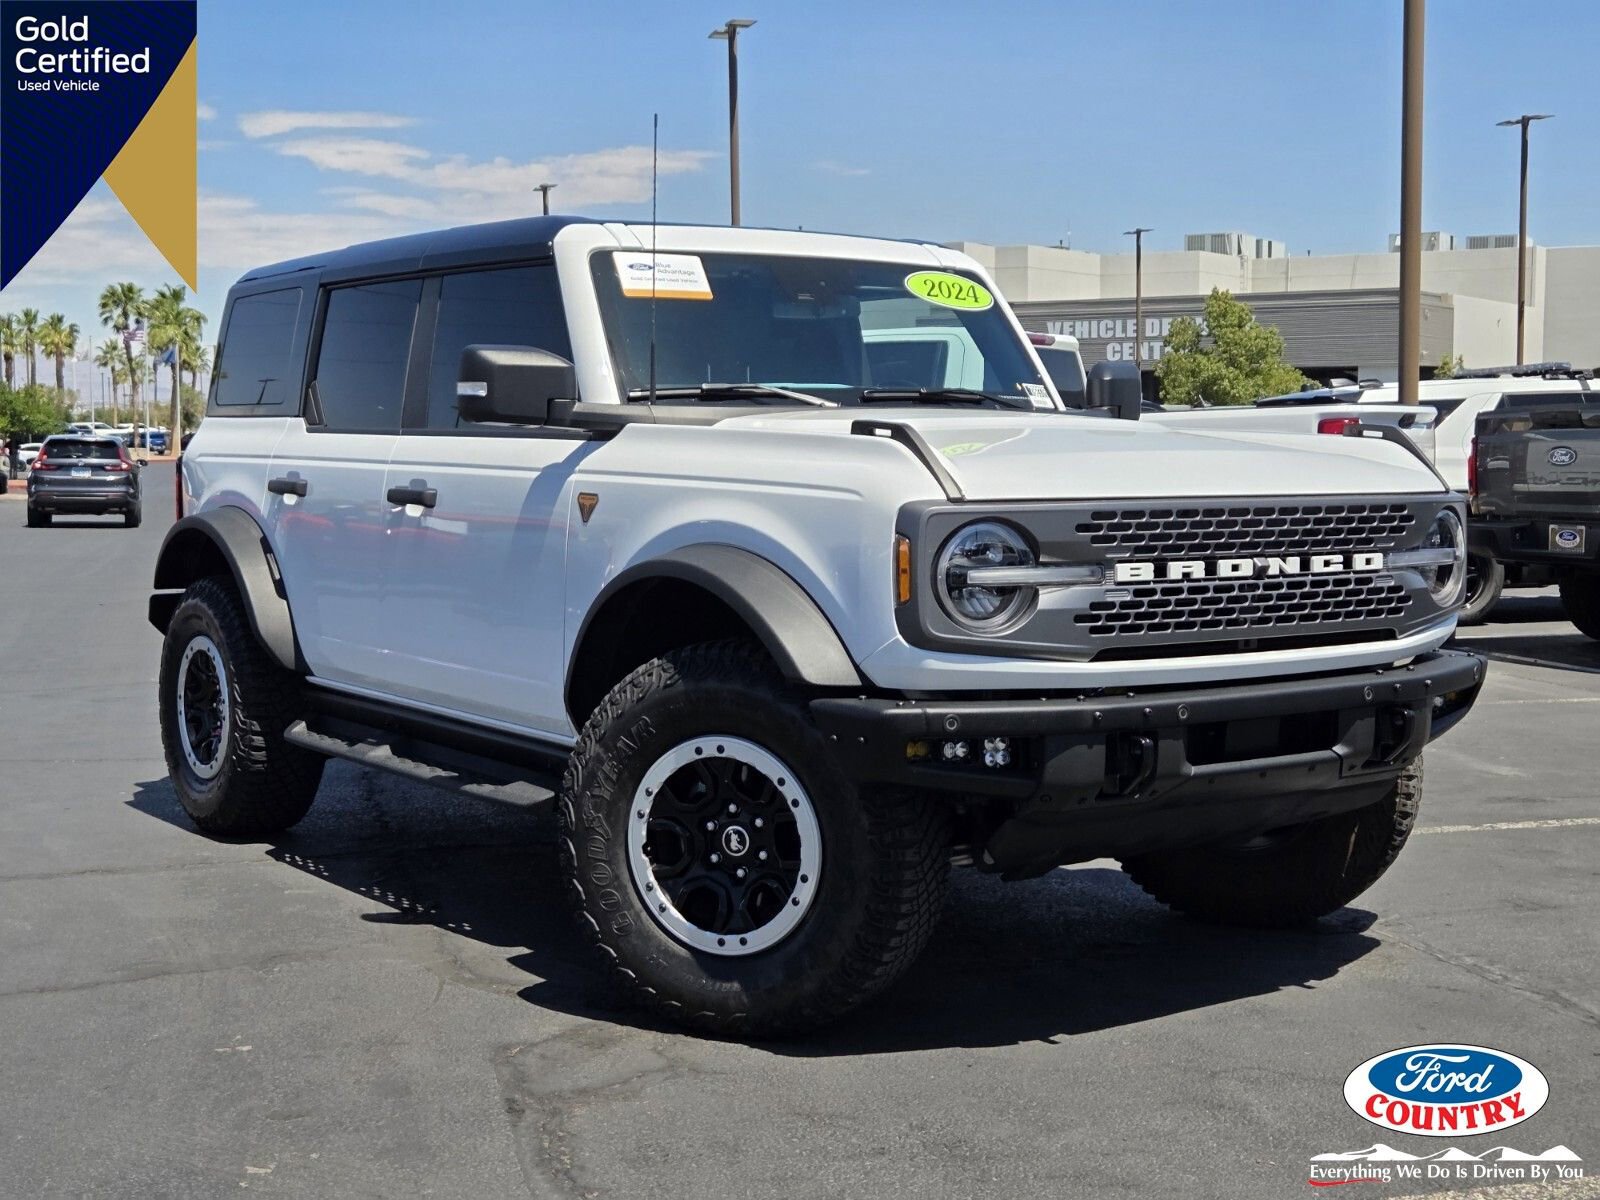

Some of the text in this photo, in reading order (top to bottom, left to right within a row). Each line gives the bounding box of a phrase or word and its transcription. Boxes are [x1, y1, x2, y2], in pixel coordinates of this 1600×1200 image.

[923, 278, 980, 303] 2024
[1046, 319, 1137, 338] VEHICLE
[1106, 341, 1190, 361] CENT
[1552, 449, 1571, 462] Ford
[1114, 552, 1384, 583] BRONCO
[585, 715, 657, 936] GOODYEAR
